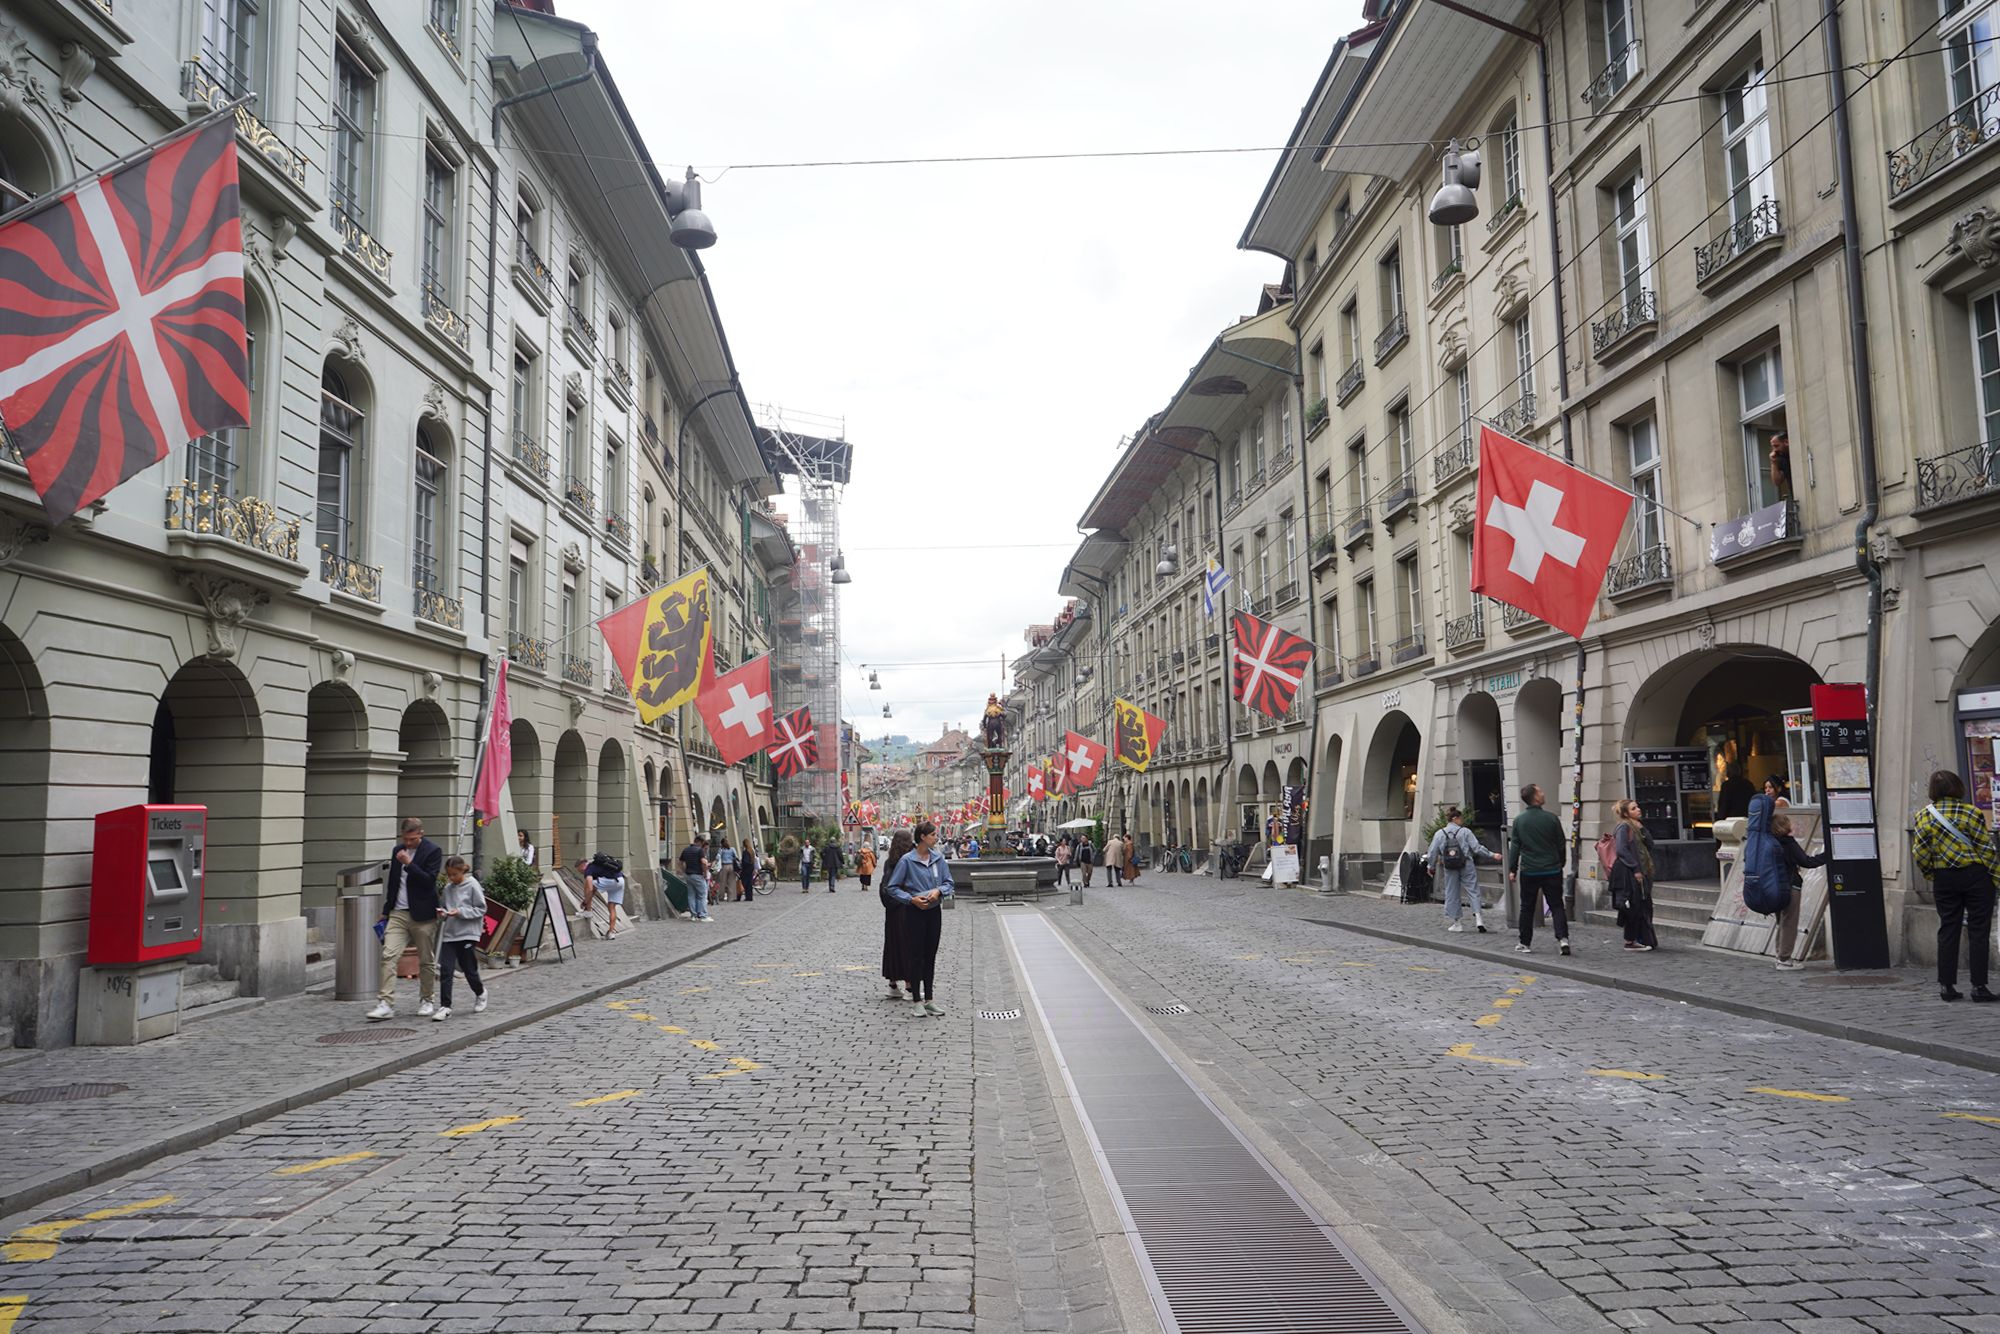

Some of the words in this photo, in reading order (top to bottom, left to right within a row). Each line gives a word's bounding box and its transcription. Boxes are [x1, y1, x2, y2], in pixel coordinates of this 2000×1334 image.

[1821, 728, 1830, 736] 12
[1838, 728, 1848, 736] 30
[152, 817, 182, 830] Tickets
